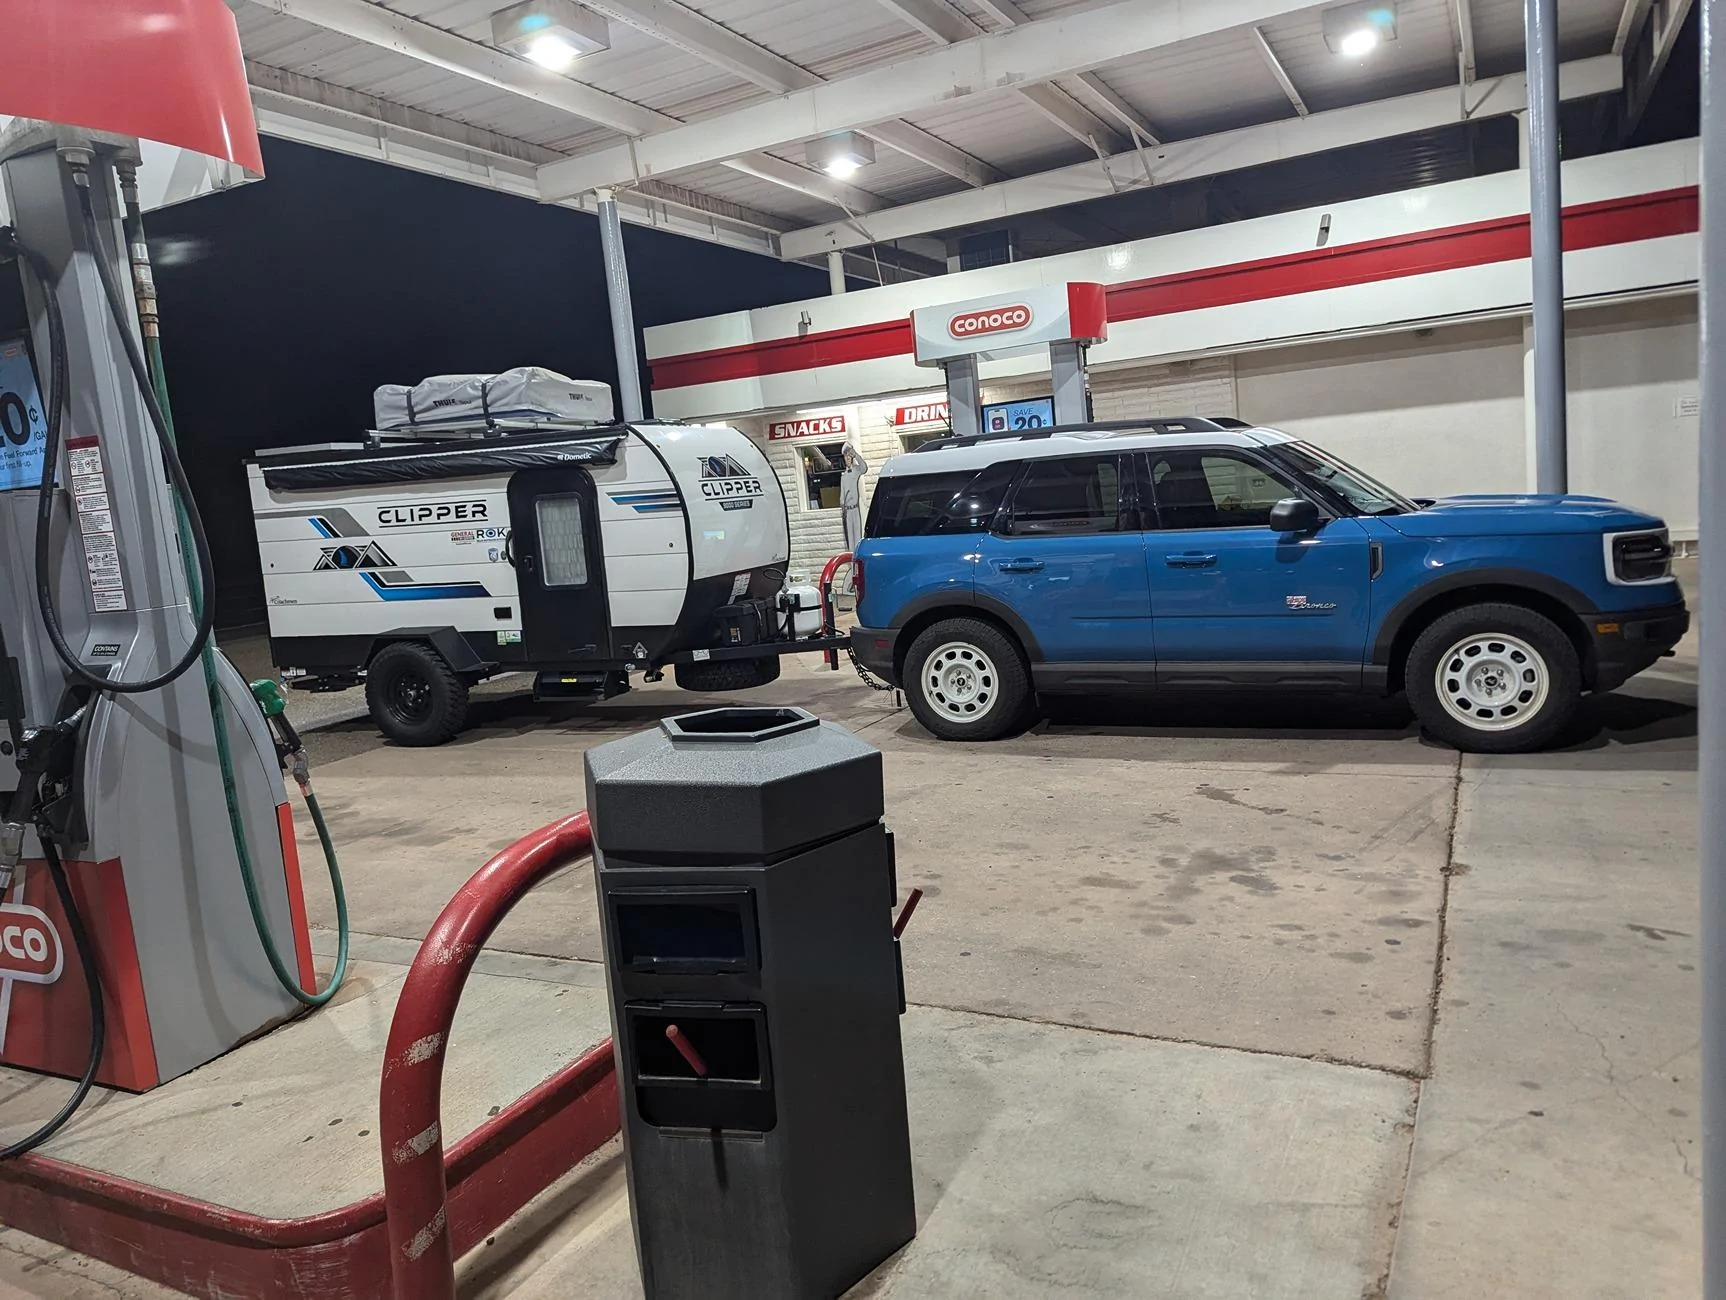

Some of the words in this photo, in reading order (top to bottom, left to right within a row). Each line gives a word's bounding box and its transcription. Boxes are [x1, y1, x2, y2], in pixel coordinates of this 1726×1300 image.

[903, 403, 949, 423] DRIN
[1013, 407, 1034, 417] SAVE
[774, 416, 843, 438] SNACKS
[564, 452, 592, 461] Dometic
[701, 480, 763, 496] CLIPPER
[378, 503, 488, 524] CLIPPER
